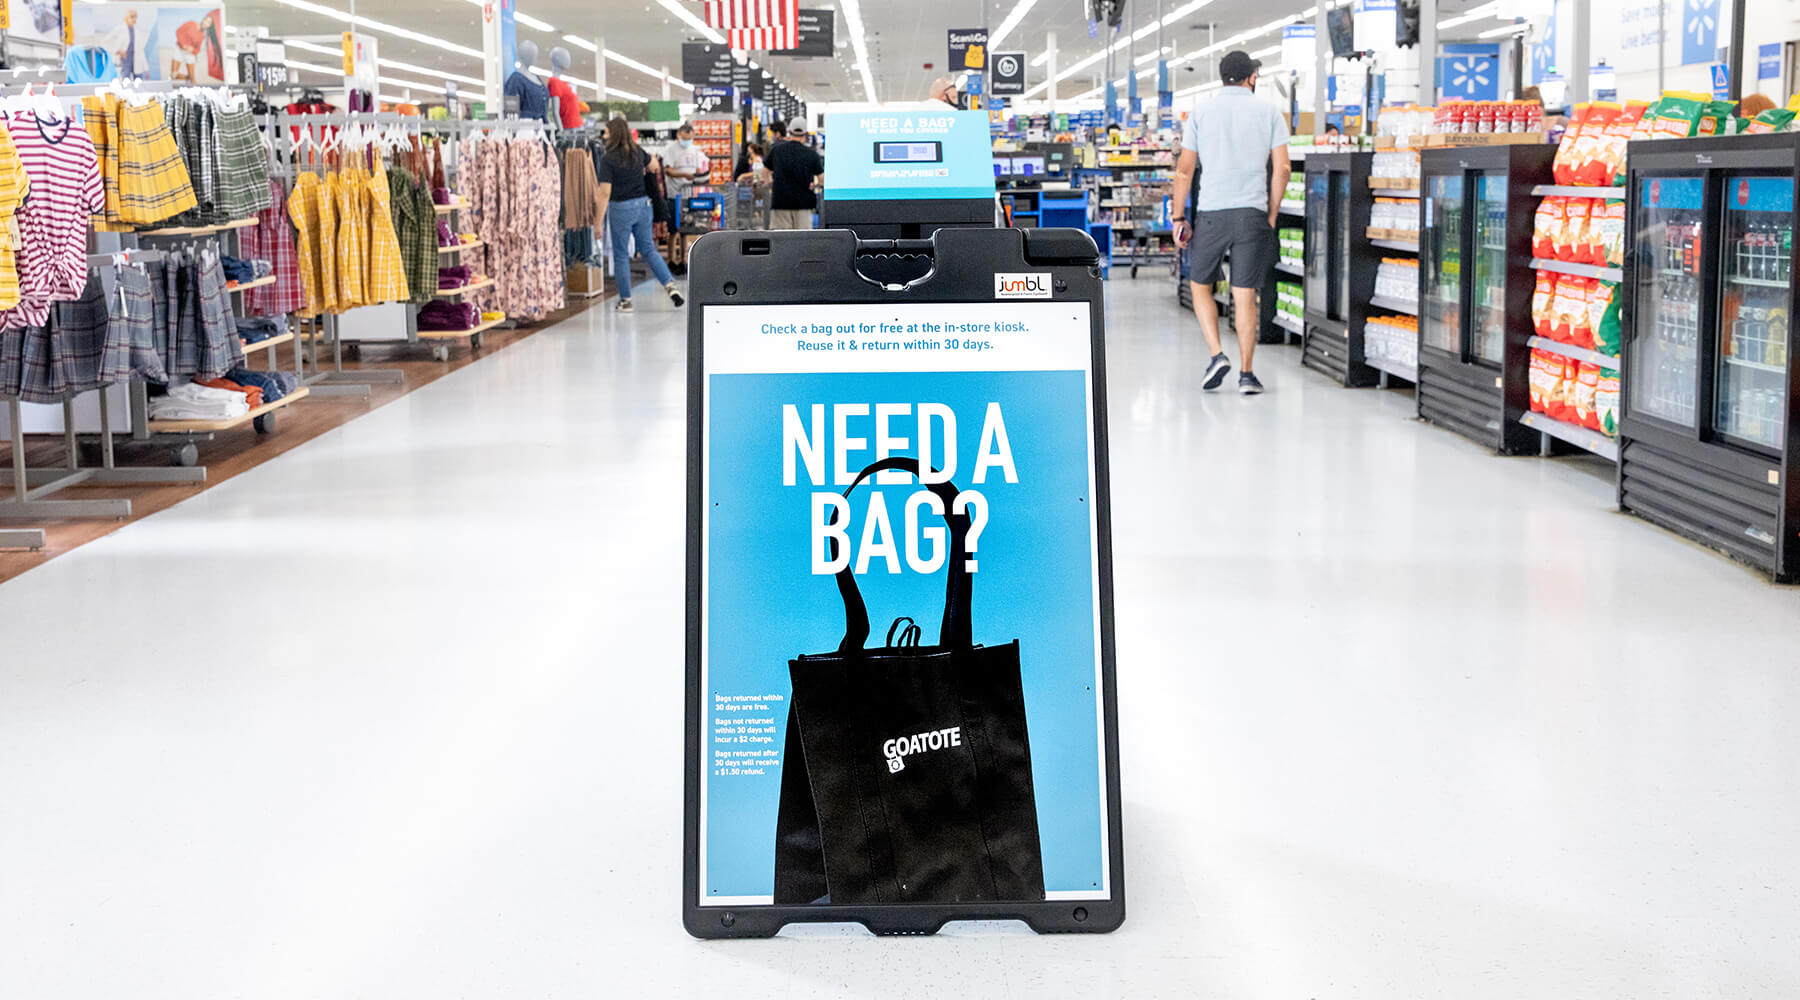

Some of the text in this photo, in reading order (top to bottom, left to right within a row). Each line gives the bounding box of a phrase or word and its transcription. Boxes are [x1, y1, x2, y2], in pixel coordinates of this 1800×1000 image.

[860, 117, 956, 129] NEED A BAG?
[999, 275, 1046, 292] jumbl
[761, 321, 1029, 336] Check a bag out for free at the in-store kiosk.
[797, 338, 994, 352] Reuse it & return within 30 days.
[782, 402, 1019, 486] NEED A
[811, 489, 989, 575] BAG?
[715, 695, 731, 703] Bags
[763, 694, 783, 702] within
[725, 704, 740, 712] days
[715, 718, 731, 726] Bags
[747, 727, 762, 735] days
[739, 735, 748, 743] $2
[749, 736, 774, 744] charge.
[883, 726, 961, 759] GOATOTE
[715, 750, 731, 758] Bags
[725, 759, 740, 767] days
[720, 768, 740, 776] $1.50
